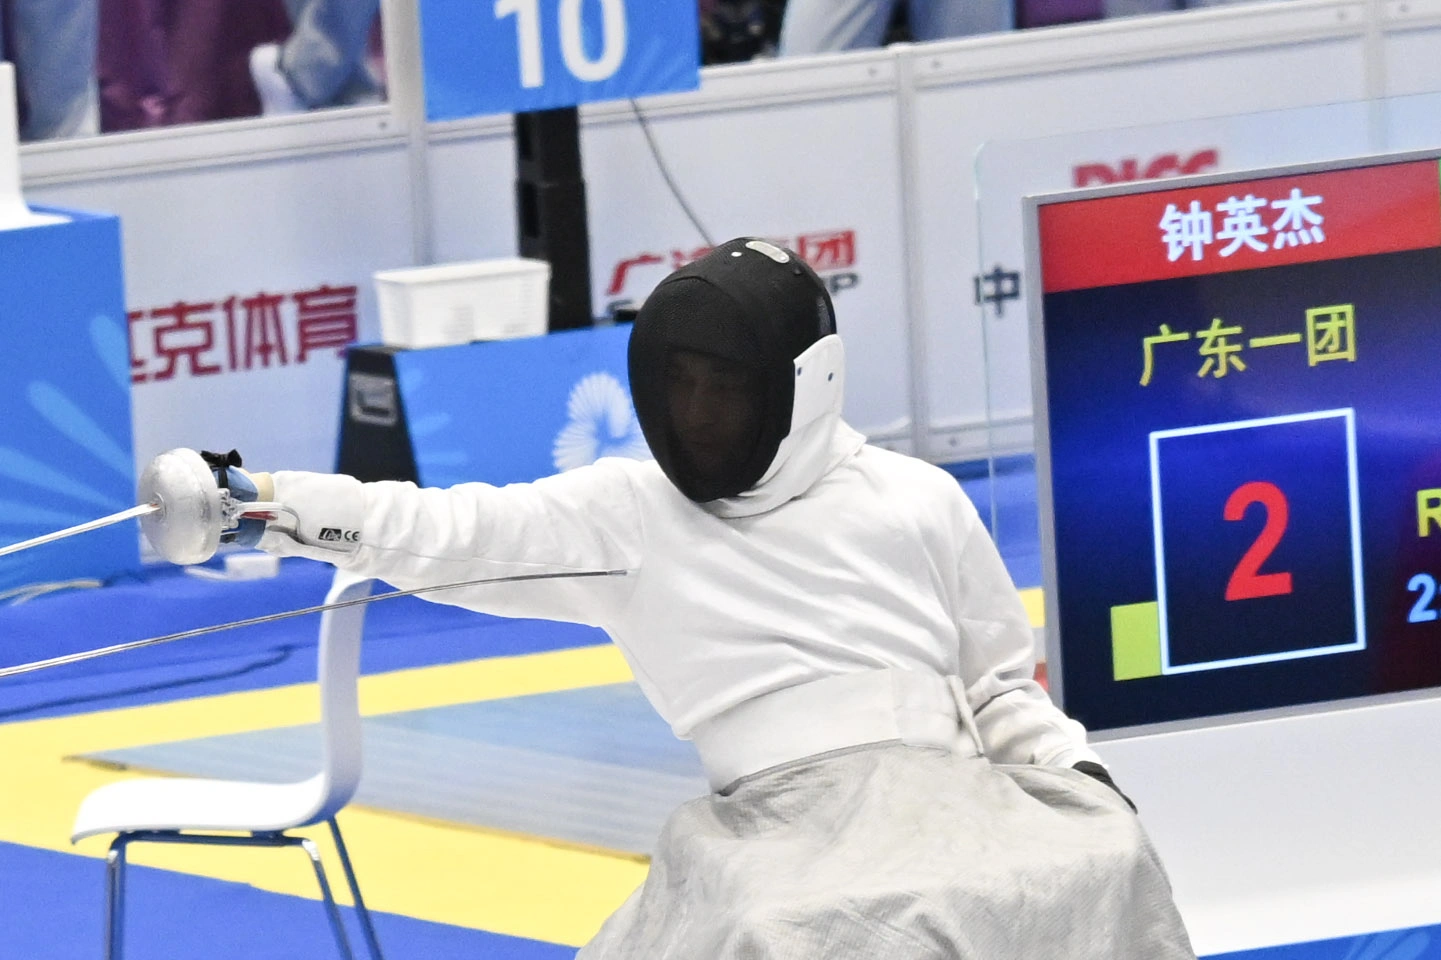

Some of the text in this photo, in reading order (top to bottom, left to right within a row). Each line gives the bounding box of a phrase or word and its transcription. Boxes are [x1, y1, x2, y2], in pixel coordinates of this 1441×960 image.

[494, 0, 628, 88] 10
[1159, 187, 1326, 262] 钟英杰
[1140, 303, 1358, 387] 广东一团
[1223, 481, 1293, 601] 2
